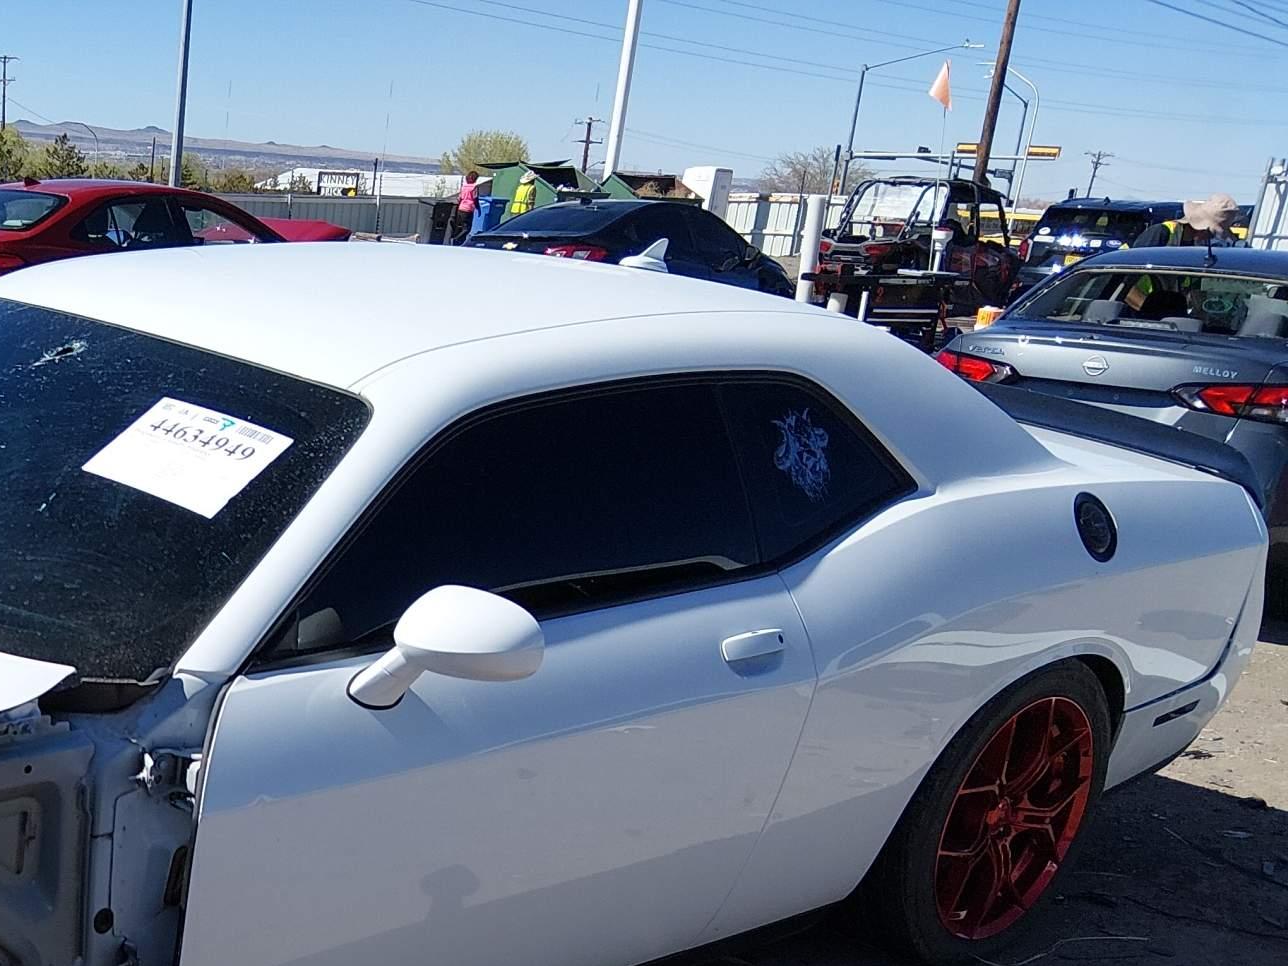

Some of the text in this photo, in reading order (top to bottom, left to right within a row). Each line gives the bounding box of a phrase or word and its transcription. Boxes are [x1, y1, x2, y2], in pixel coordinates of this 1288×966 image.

[320, 174, 357, 185] KINNEY
[1192, 365, 1238, 379] MELLOY
[149, 417, 256, 461] 44634949
